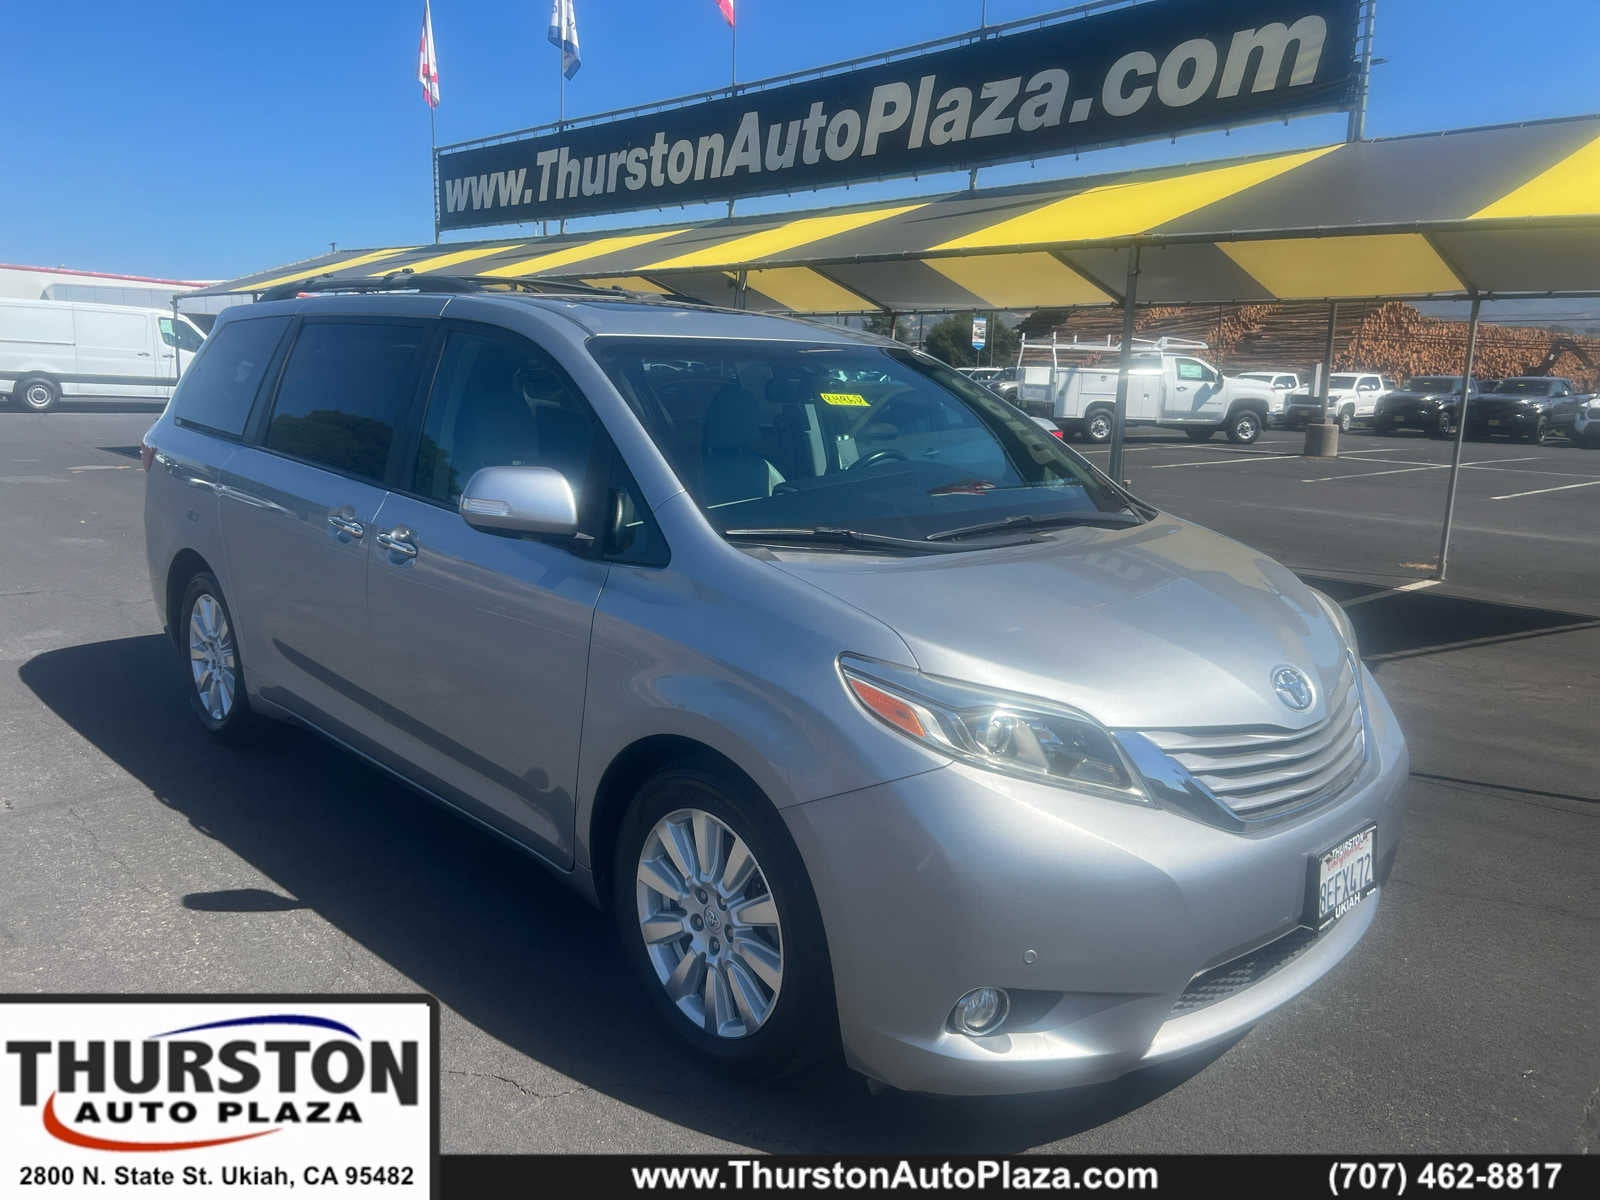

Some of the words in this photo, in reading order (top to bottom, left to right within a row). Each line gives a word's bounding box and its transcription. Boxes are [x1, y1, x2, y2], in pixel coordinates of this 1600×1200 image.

[445, 15, 1327, 213] www.ThurstonAutoPlaza.com
[1320, 853, 1372, 914] 8EFX472
[1335, 892, 1361, 918] UKIAH
